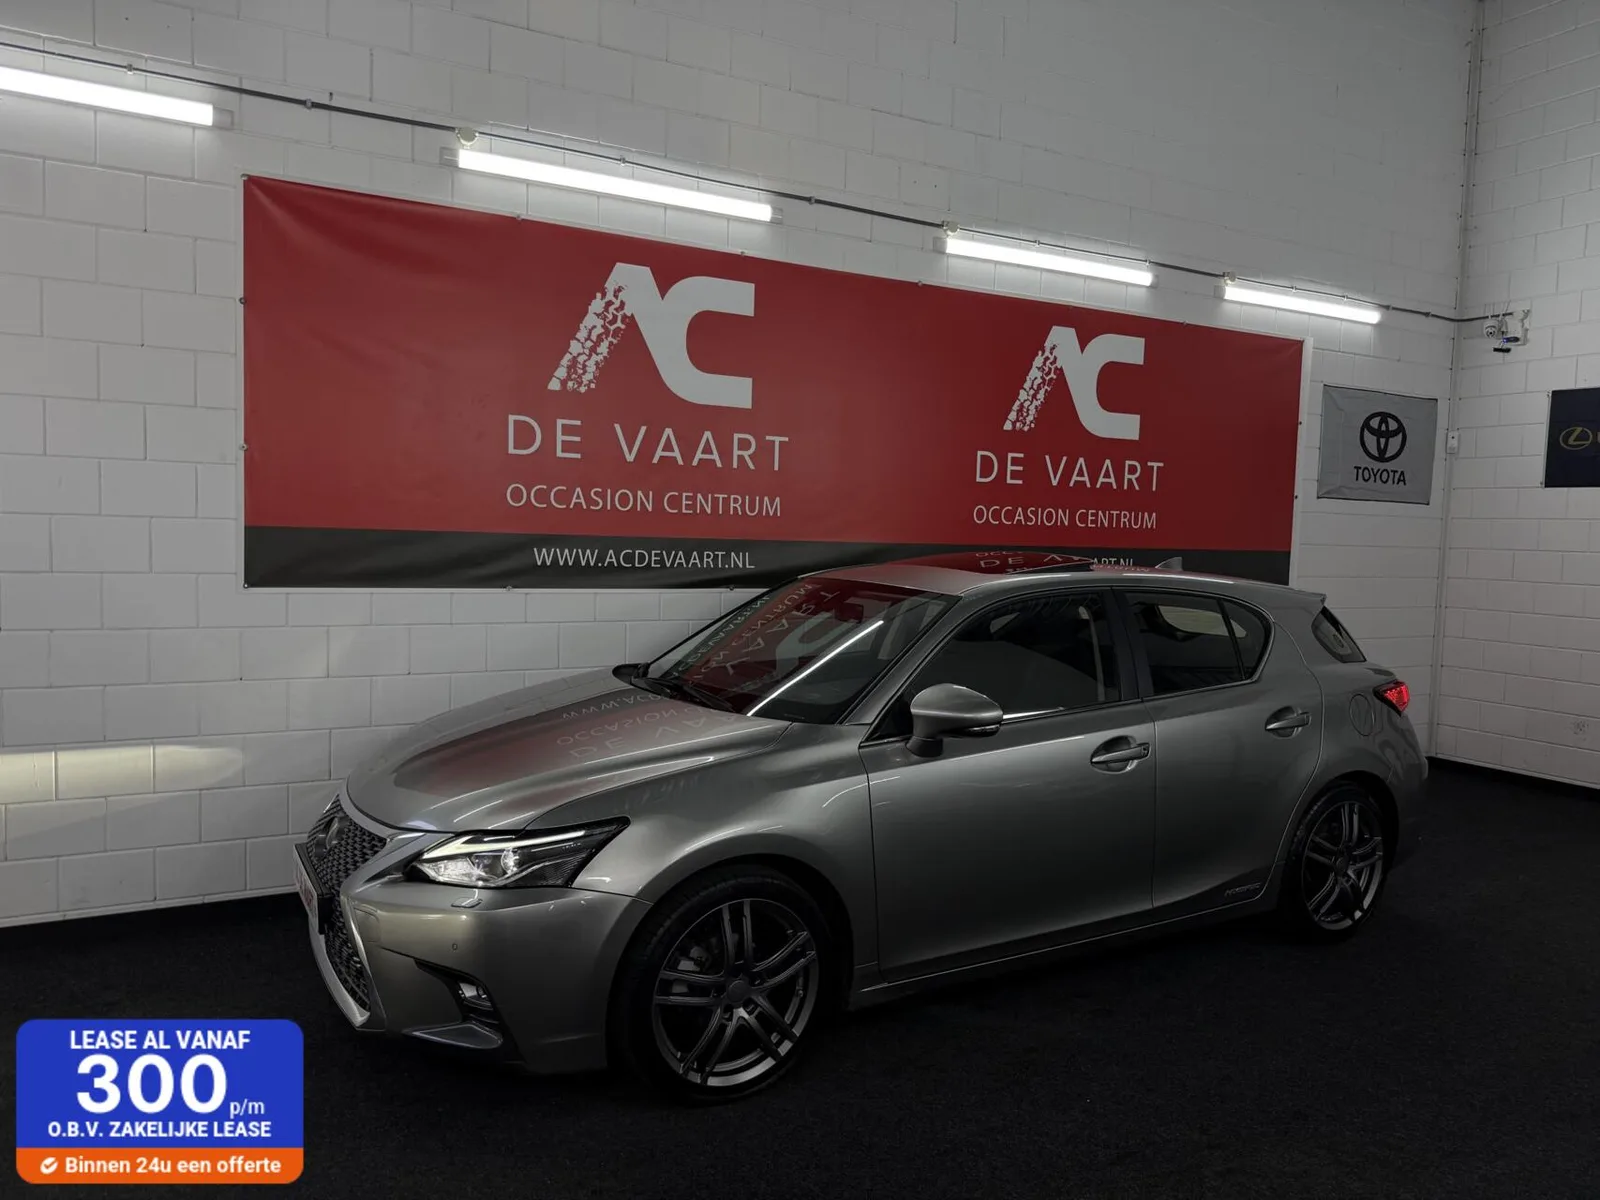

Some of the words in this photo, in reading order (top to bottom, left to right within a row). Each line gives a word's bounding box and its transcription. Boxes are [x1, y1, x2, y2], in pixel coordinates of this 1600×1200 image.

[547, 262, 755, 409] AC
[1003, 325, 1145, 440] AC
[508, 414, 582, 459] DE
[614, 423, 789, 471] VAART
[975, 450, 1025, 485] DE
[1045, 455, 1164, 492] VAART
[1354, 466, 1407, 486] TOYOTA
[506, 483, 653, 512] OCCASION
[663, 492, 781, 517] CENTRUM
[973, 505, 1069, 527] OCCASION
[1075, 510, 1157, 529] CENTRUM
[533, 547, 755, 569] WWW.ACDEVAART.NL
